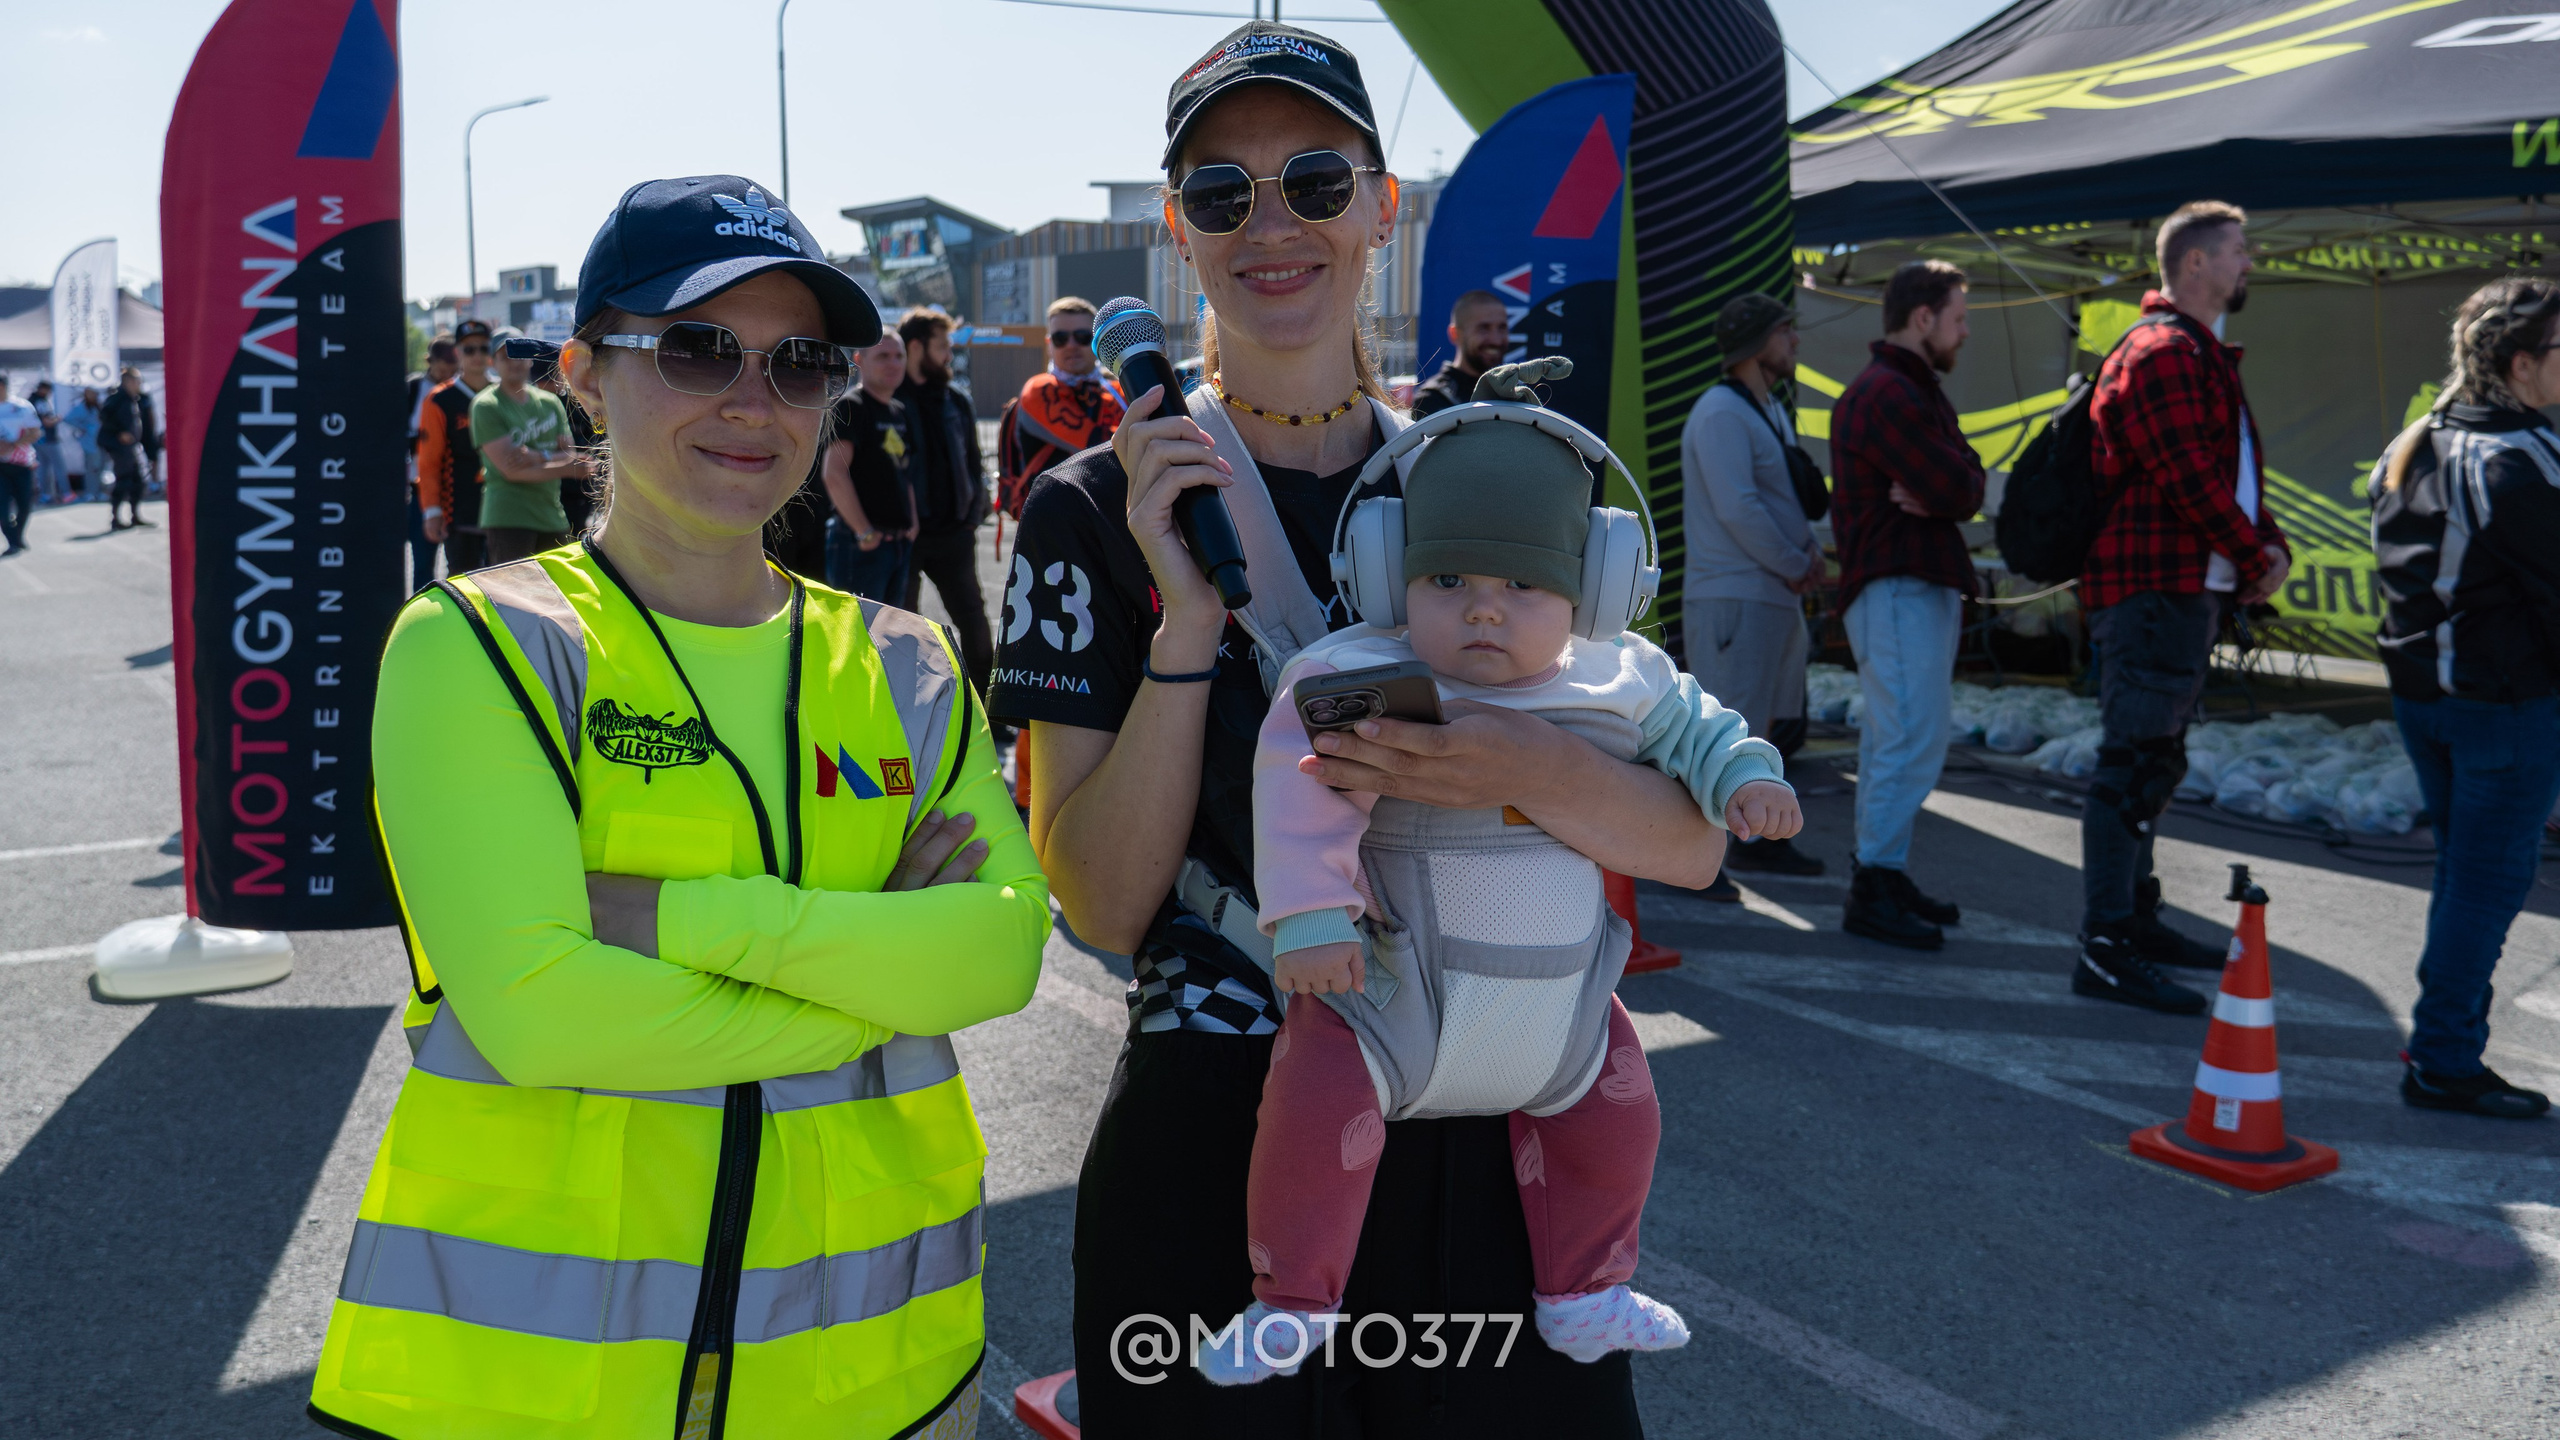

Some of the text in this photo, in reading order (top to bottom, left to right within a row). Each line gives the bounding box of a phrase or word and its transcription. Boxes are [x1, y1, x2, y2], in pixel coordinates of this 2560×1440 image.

[1182, 35, 1331, 84] MOTOGYMKHANA
[1192, 45, 1318, 80] EKATERINBURG TEAM
[715, 219, 800, 253] adidas
[231, 197, 299, 896] MOTOGYMKHANA
[308, 196, 347, 896] EKATERINBURG TEAM
[614, 738, 685, 765] ALEX377
[888, 766, 904, 786] K
